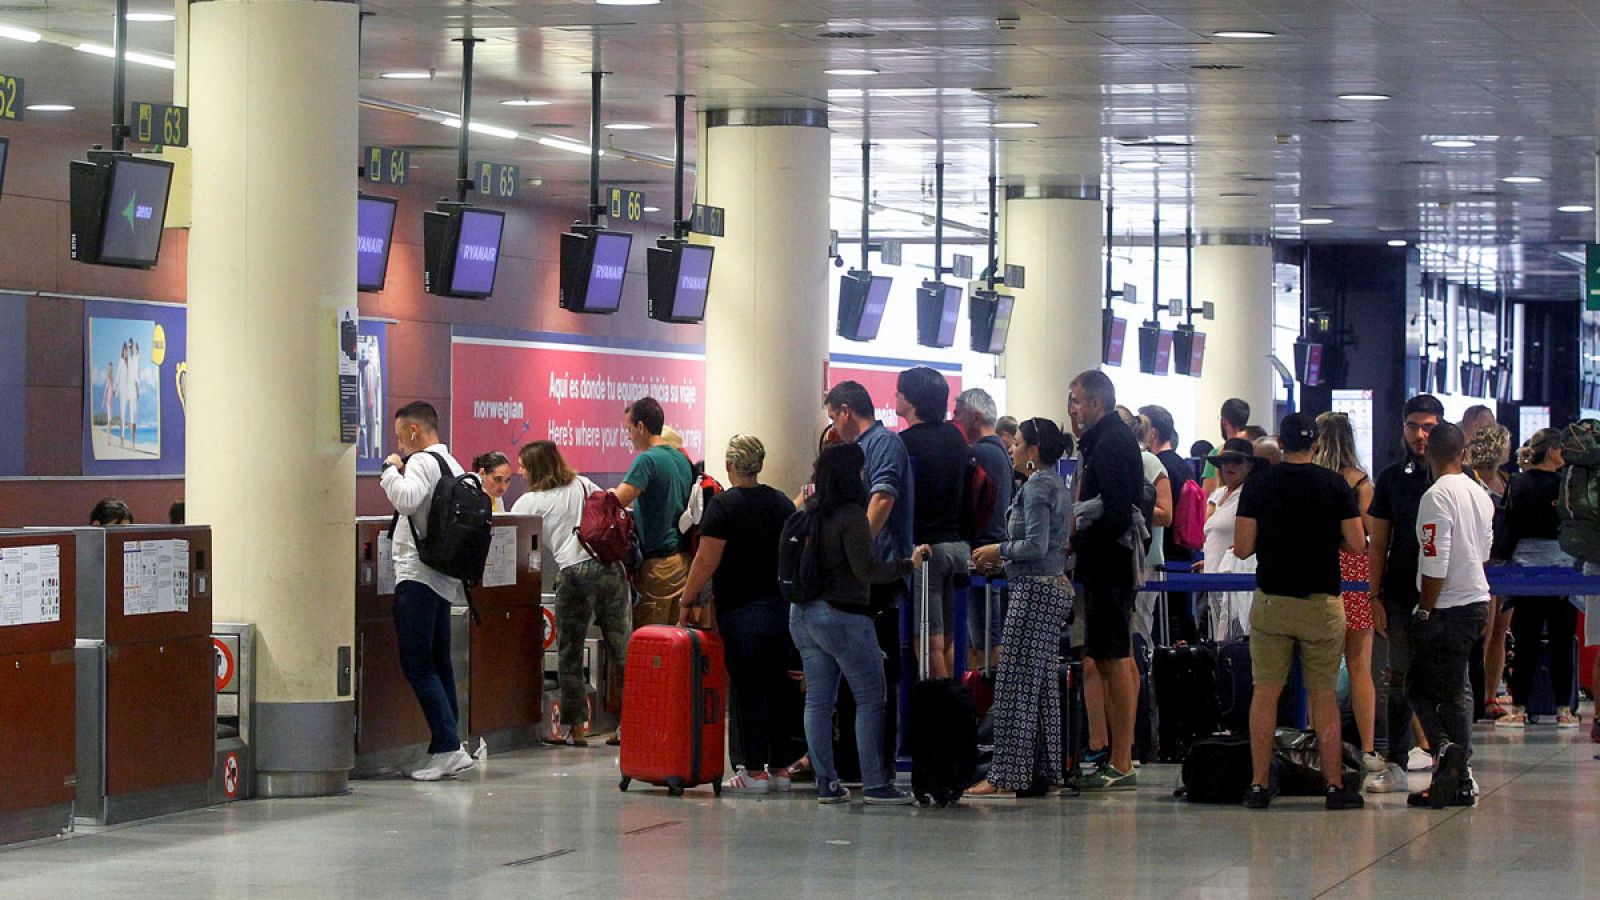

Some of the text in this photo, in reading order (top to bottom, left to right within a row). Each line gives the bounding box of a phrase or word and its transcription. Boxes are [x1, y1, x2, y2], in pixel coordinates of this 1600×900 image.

[164, 107, 181, 144] 63
[390, 151, 405, 184] 64
[500, 166, 514, 196] 65
[628, 191, 641, 221] 66
[357, 236, 384, 254] YANAIR
[463, 245, 496, 261] RYANAIR
[595, 265, 624, 280] RYANAIR
[681, 276, 707, 290] RYANAIR
[549, 371, 569, 405] Aquí
[570, 380, 579, 399] es
[580, 373, 605, 400] donde
[608, 375, 616, 400] tu
[671, 385, 679, 403] su
[680, 379, 696, 409] viaje
[475, 396, 524, 425] norwegian
[548, 419, 573, 447] Here's
[575, 421, 600, 447] where
[602, 427, 619, 453] your
